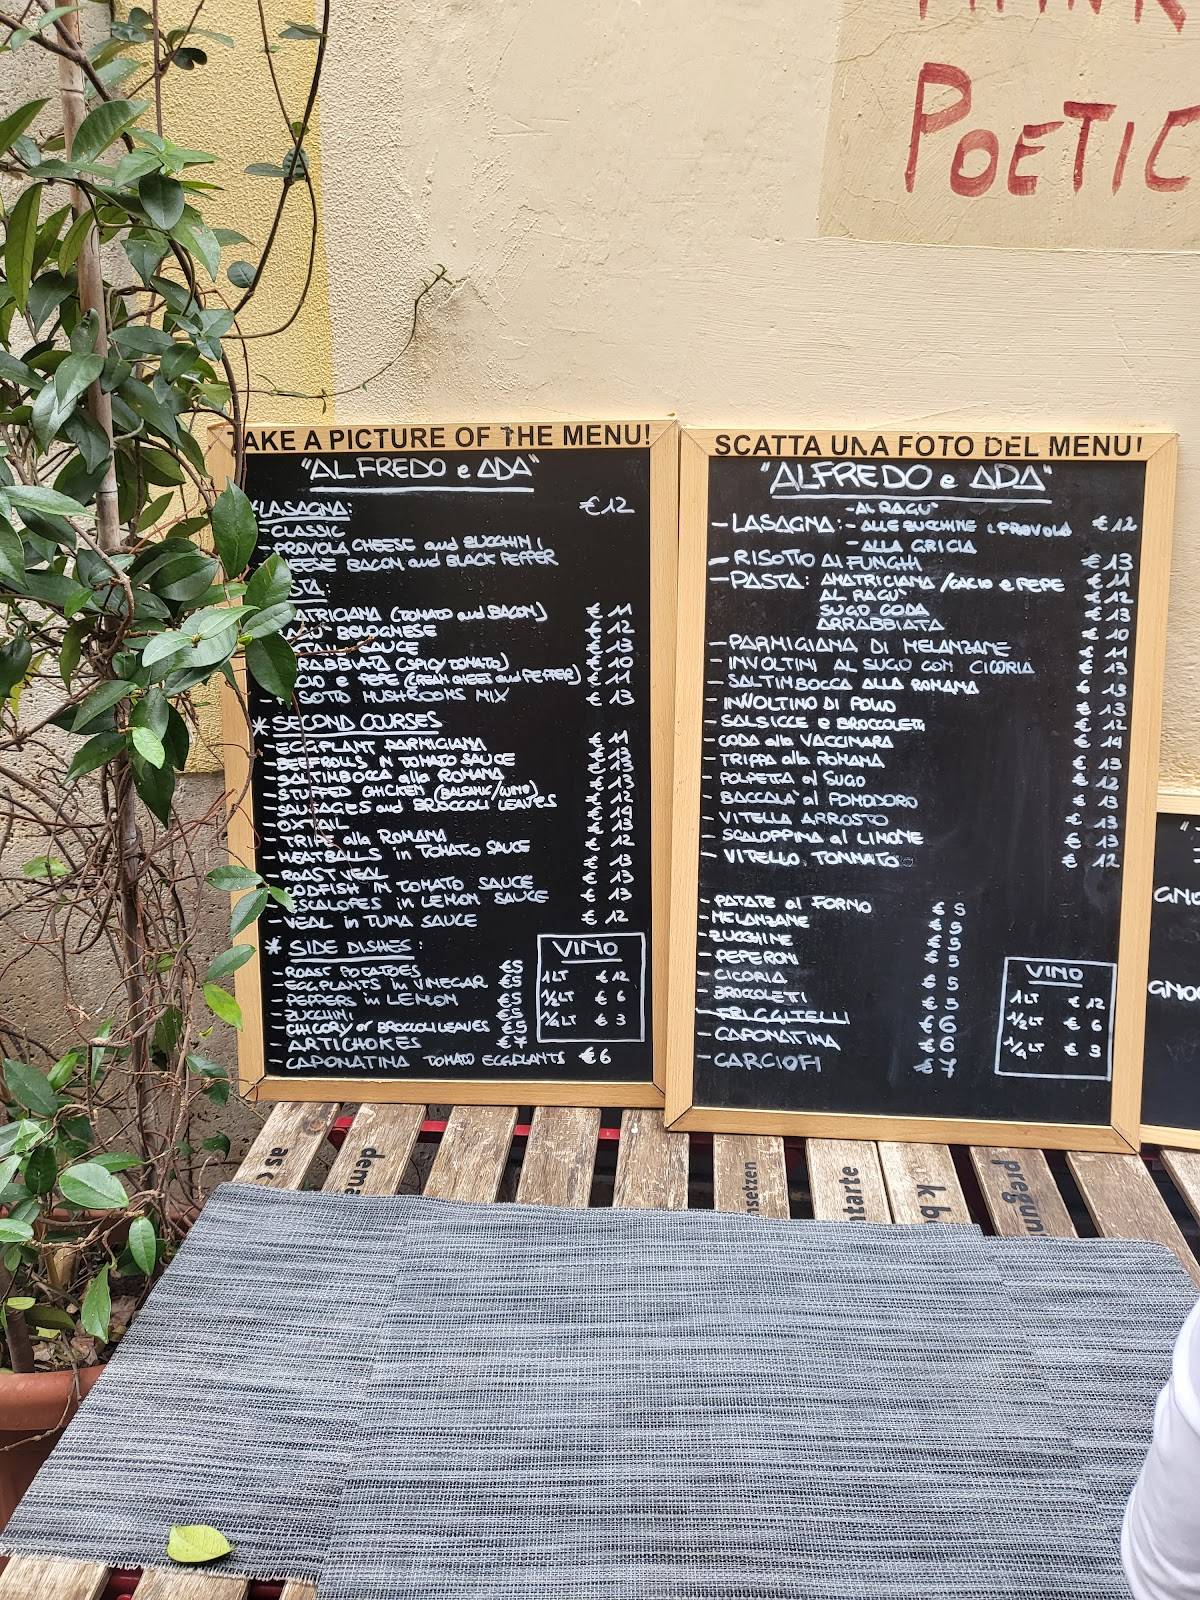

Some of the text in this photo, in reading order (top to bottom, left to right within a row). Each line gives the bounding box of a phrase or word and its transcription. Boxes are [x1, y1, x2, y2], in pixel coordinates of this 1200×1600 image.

[304, 430, 322, 450] A
[329, 428, 445, 450] PICTURE
[455, 426, 491, 447] OF
[501, 425, 553, 447] THE
[563, 424, 650, 446] MENU!
[715, 434, 821, 456] SCATTA
[831, 435, 890, 456] UNA
[898, 435, 974, 457] FOTO
[985, 436, 1039, 457] DEL
[457, 466, 471, 478] e
[940, 473, 958, 489] e
[271, 525, 346, 538] CLASSIC
[861, 519, 899, 533] ALLE
[273, 540, 350, 556] PROVOLA
[352, 538, 416, 553] CHEESE
[424, 537, 458, 551] and
[861, 539, 977, 554] ALLA GRICIA
[346, 549, 559, 573] BACON and BLACK PEPPER
[734, 549, 815, 567] RISOTTO
[847, 554, 922, 571] FUNGHI
[821, 573, 935, 589] AMATRICIANA
[1016, 578, 1065, 592] PEPE
[819, 589, 847, 602] AL
[457, 605, 485, 621] and
[820, 603, 930, 617] SUGO CODA
[337, 624, 437, 640] BOLOGNESE
[816, 617, 945, 632] ARRABBIATA
[728, 634, 858, 654] PARMIGIANA
[870, 638, 889, 654] DI
[728, 656, 817, 672] INVOLTINI
[833, 659, 858, 673] AL
[863, 658, 912, 672] SUGO
[728, 674, 980, 695] SALTIMBOCCA ALLA ROMANA
[475, 687, 510, 704] MIX
[824, 698, 839, 711] DI
[272, 711, 442, 731] SECOND COURSES
[720, 714, 809, 729] SALSICCE
[718, 734, 760, 748] CODA
[398, 754, 457, 769] TOMATO
[460, 753, 515, 767] SAUCE
[719, 750, 885, 768] TRIPPA alla ROMANA
[277, 767, 504, 787] SALTIMBOCCA alla ROMANA
[720, 770, 866, 788] POLPETTA SUGO
[375, 800, 404, 814] and
[828, 792, 919, 809] POMODORO
[718, 811, 889, 827] VITELLA ARROSTO
[343, 831, 371, 846] alla
[377, 829, 447, 845] ROMANA
[722, 828, 824, 844] SCALOPPINA
[857, 829, 924, 846] LIMONE
[278, 839, 531, 864] MEATBALLS in TOMATO SAUCE
[723, 848, 800, 866] VITELLO
[281, 867, 388, 882] ROAST VEAL
[284, 875, 533, 897] CODFISH TOMATO SAUCE
[397, 890, 549, 911] in LEMON SAUCE
[714, 895, 776, 909] PATATE
[811, 896, 872, 914] FORNO
[283, 913, 478, 930] VEAL in TUNA SAUCE
[711, 910, 810, 928] MELANZANE
[709, 929, 793, 946] ZUCCHINE
[288, 939, 338, 957] SIDE
[715, 949, 799, 966] PEPERONI
[284, 964, 421, 979] ROAST POTATOES
[714, 968, 788, 984] CICORIA
[1025, 963, 1084, 981] VINO
[284, 975, 488, 992] EGGPLANTS in VINEGAR
[285, 992, 459, 1007] PEPPERS in LEMON
[356, 1020, 373, 1032] or
[287, 1036, 422, 1052] ARTICHOKES
[714, 1027, 843, 1051] CAPONATINA
[286, 1055, 410, 1070] CAPONATINA
[713, 1053, 822, 1073] CARCIOFI
[992, 1159, 1049, 1236] pregun
